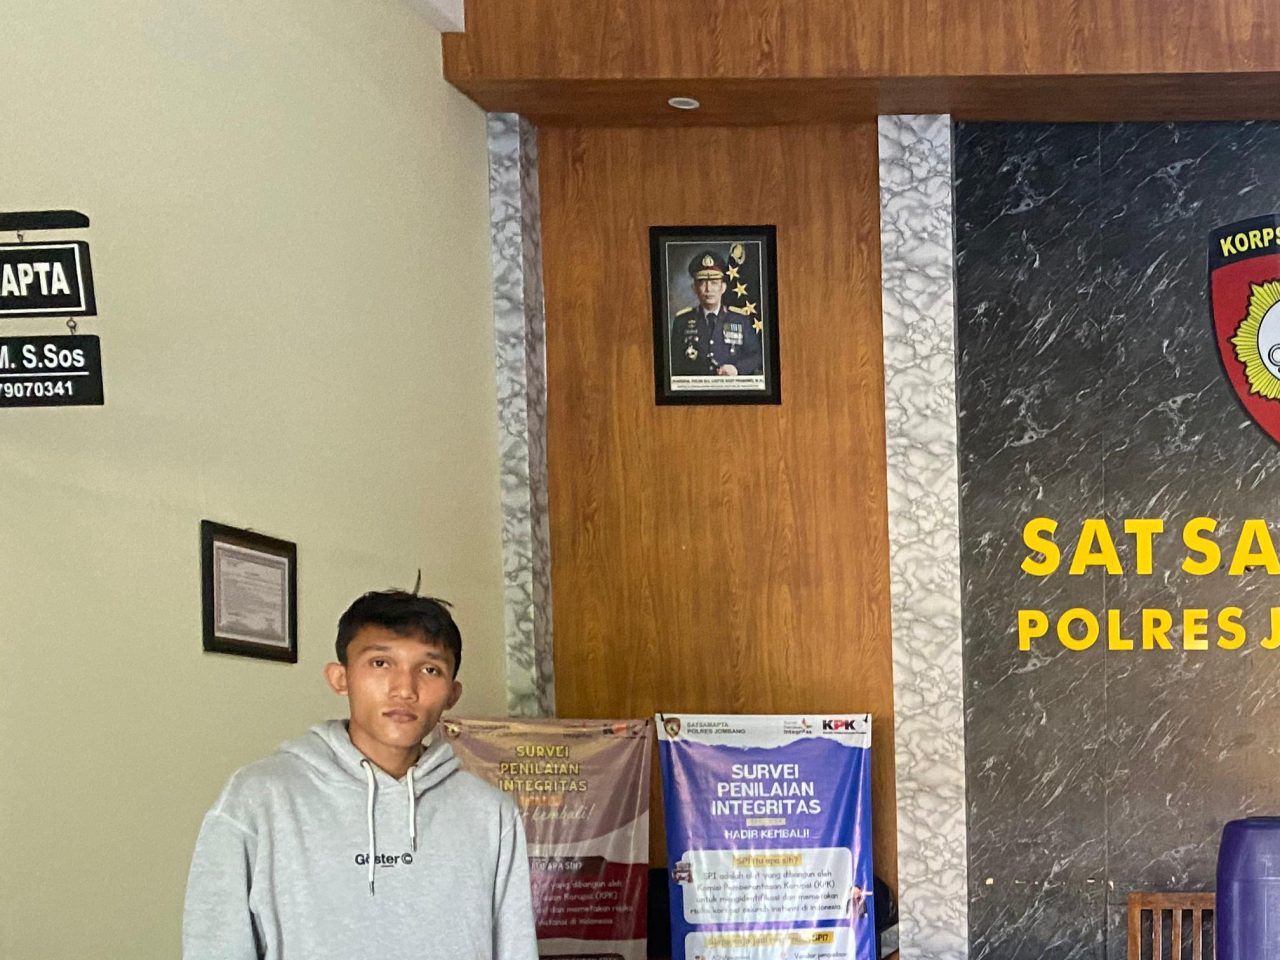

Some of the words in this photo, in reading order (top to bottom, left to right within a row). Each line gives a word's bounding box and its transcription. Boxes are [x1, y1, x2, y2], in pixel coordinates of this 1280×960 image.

[22, 344, 86, 368] S.Sos
[0, 380, 73, 397] 9070341
[1020, 518, 1164, 576] SAT
[1018, 607, 1247, 651] POLRES
[822, 719, 855, 730] KPK
[516, 745, 569, 758] SURVEI
[500, 762, 579, 775] PENILAIAN
[731, 764, 799, 779] SURVEI
[717, 781, 814, 798] PENILAIAN
[711, 799, 822, 816] INTEGRITAS
[724, 830, 758, 840] HADIR
